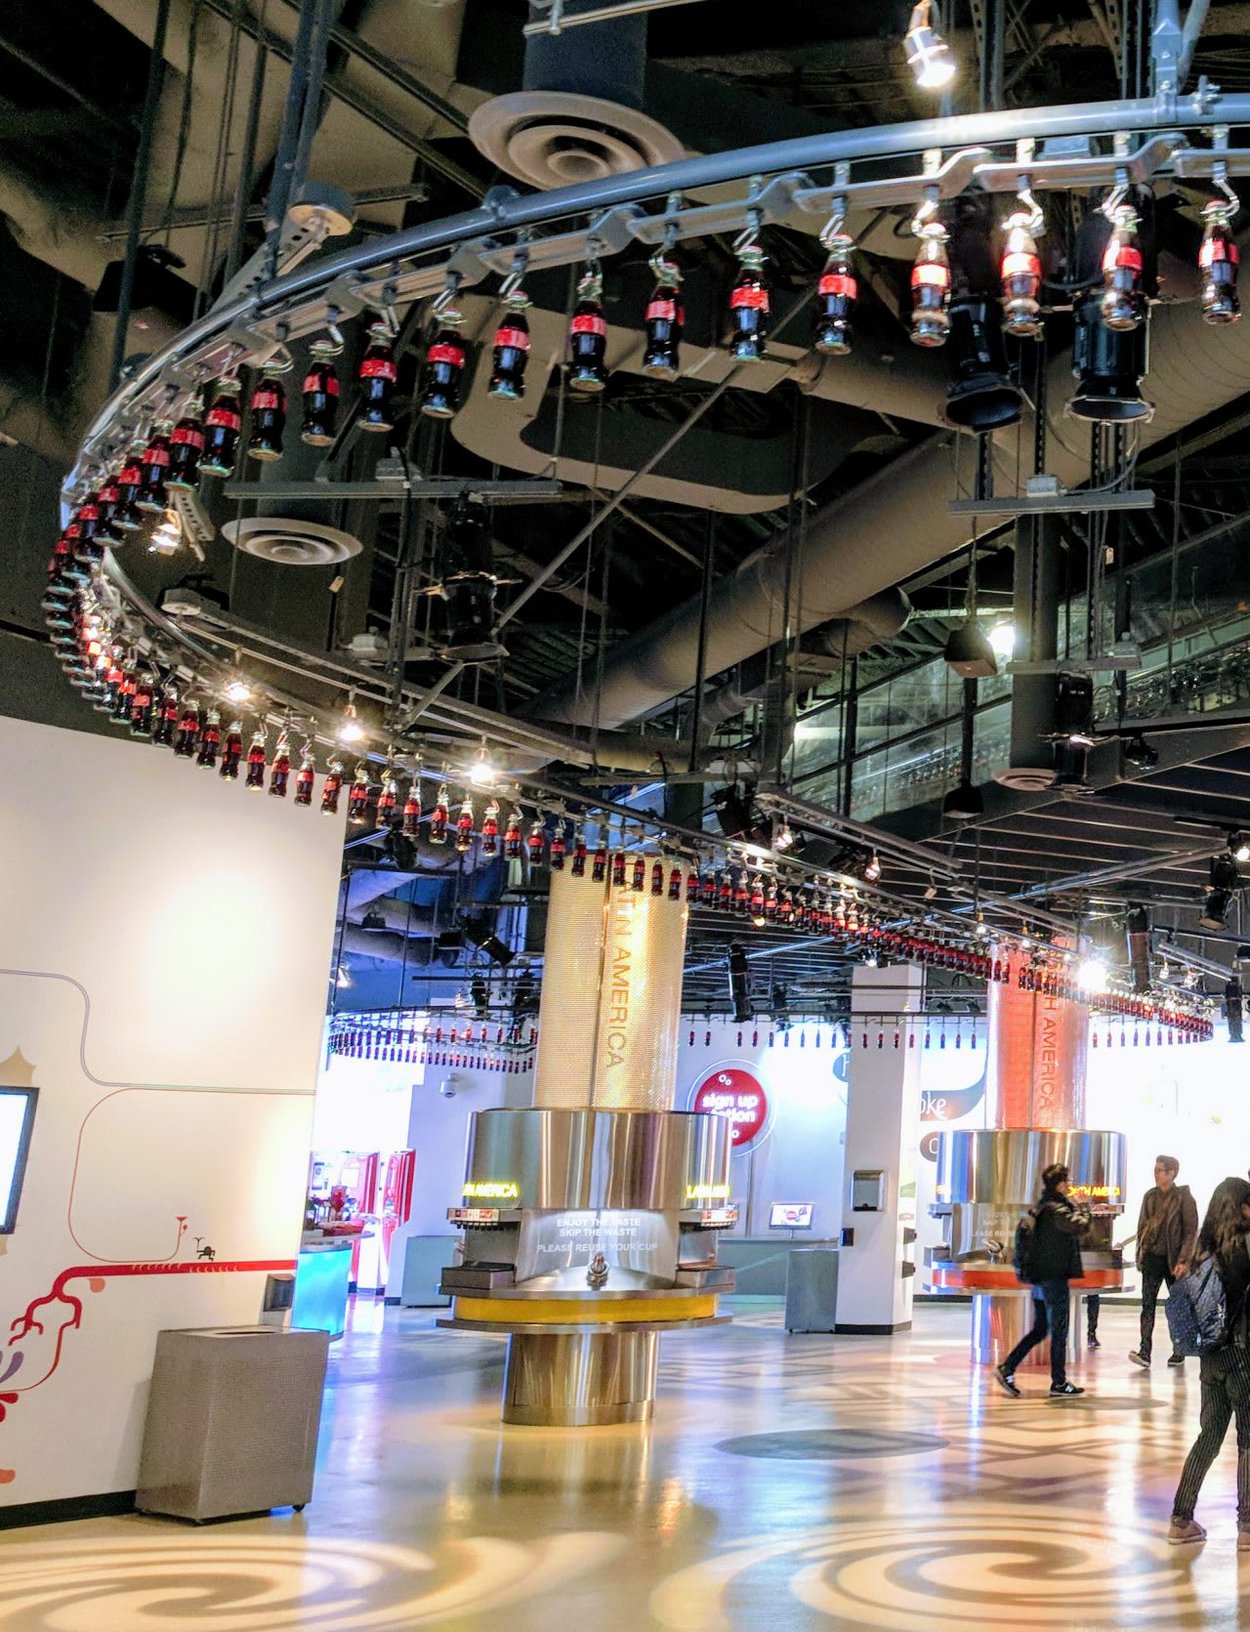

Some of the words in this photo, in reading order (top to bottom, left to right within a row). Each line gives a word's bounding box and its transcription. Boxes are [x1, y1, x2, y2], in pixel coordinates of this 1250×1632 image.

[606, 945, 632, 1068] AMERICA
[1040, 1017, 1057, 1110] AMERICA
[702, 1093, 735, 1111] sign
[737, 1095, 759, 1110] up
[920, 1091, 946, 1121] oke
[710, 1108, 756, 1123] tion
[556, 1218, 590, 1227] ENJOY
[559, 1228, 581, 1237] SKIP
[583, 1228, 602, 1237] THE
[604, 1228, 637, 1237] WASTE
[537, 1244, 573, 1253] PLEASE
[575, 1244, 608, 1252] REUSE
[638, 1243, 658, 1251] CUP
